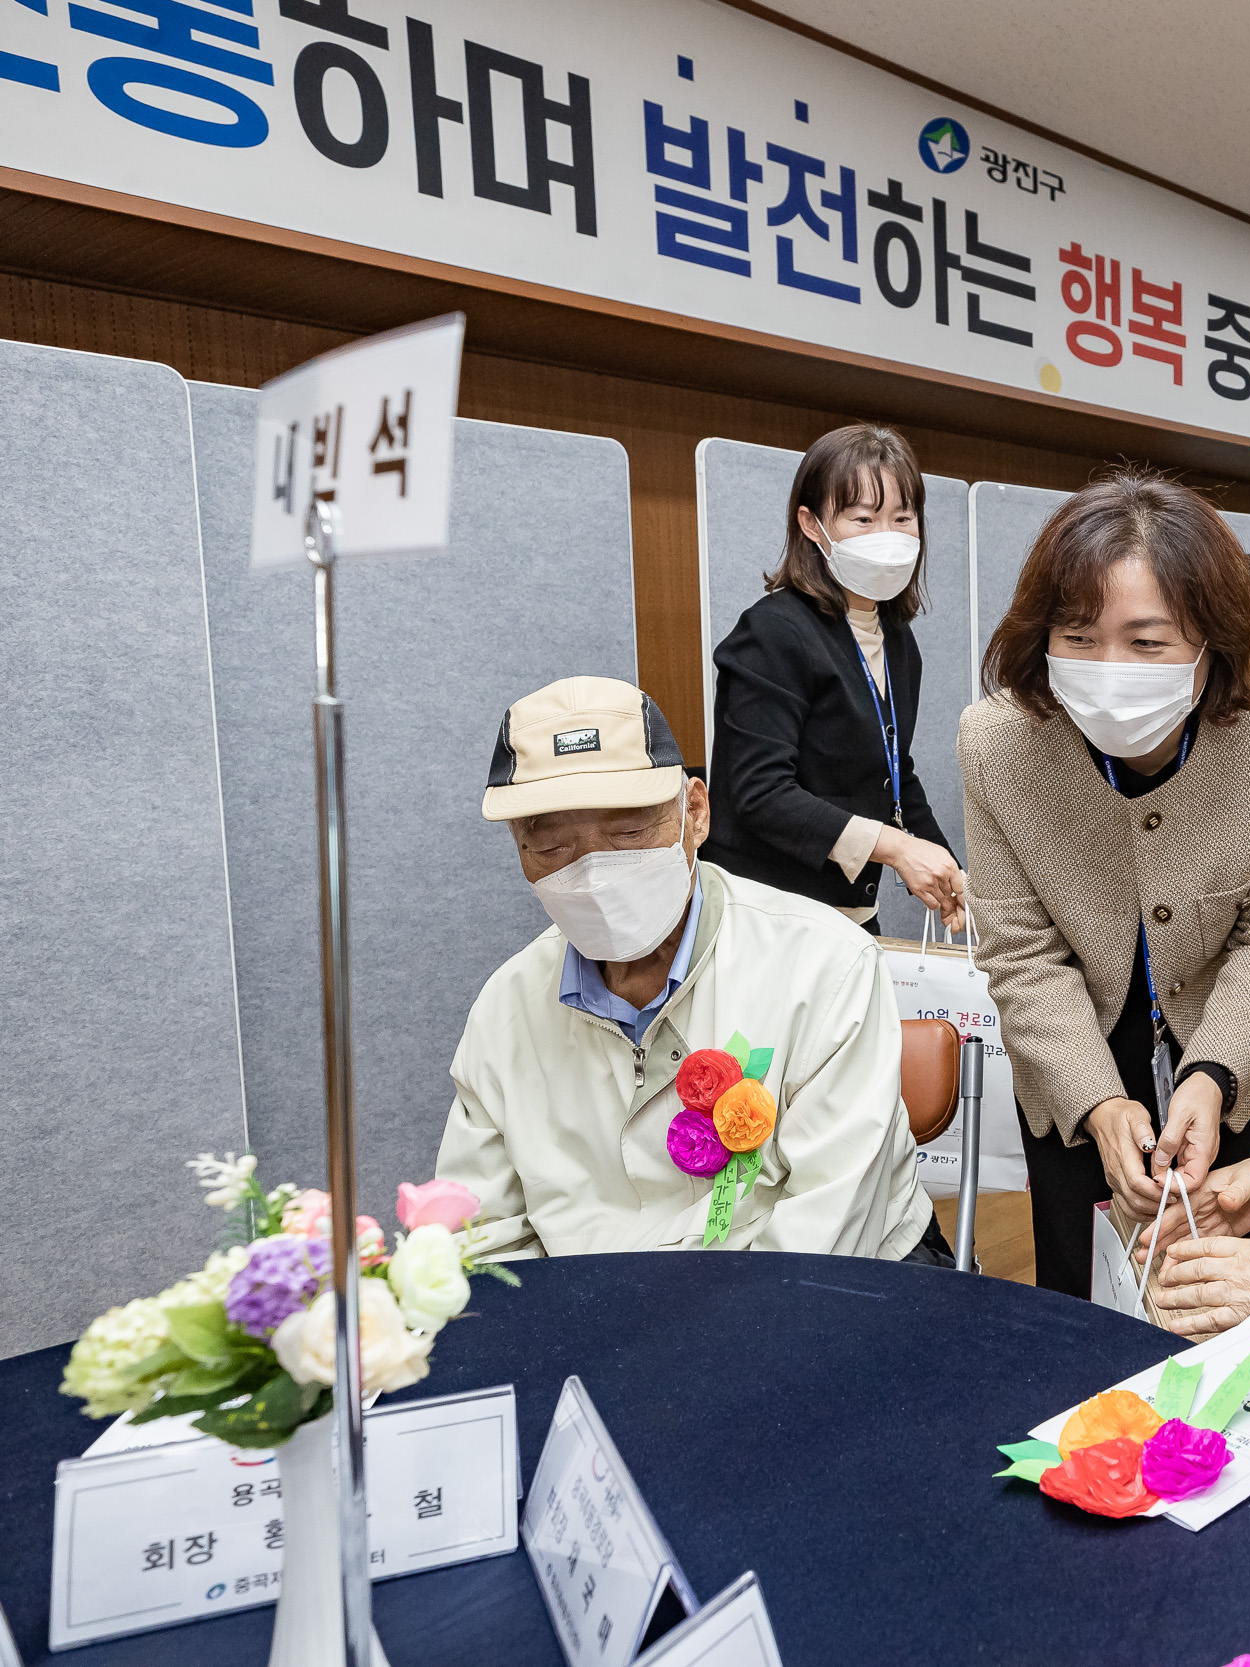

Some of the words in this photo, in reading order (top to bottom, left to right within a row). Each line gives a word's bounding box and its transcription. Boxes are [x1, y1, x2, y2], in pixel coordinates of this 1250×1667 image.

[0, 0, 597, 238] 통하며
[643, 99, 1036, 348] 발전하는
[1059, 241, 1187, 387] 행복
[979, 145, 1067, 202] 광진구
[956, 1011, 996, 1028] 경로의
[930, 1155, 958, 1164] 광진구
[141, 1531, 219, 1573] 회장
[414, 1486, 443, 1520] 철
